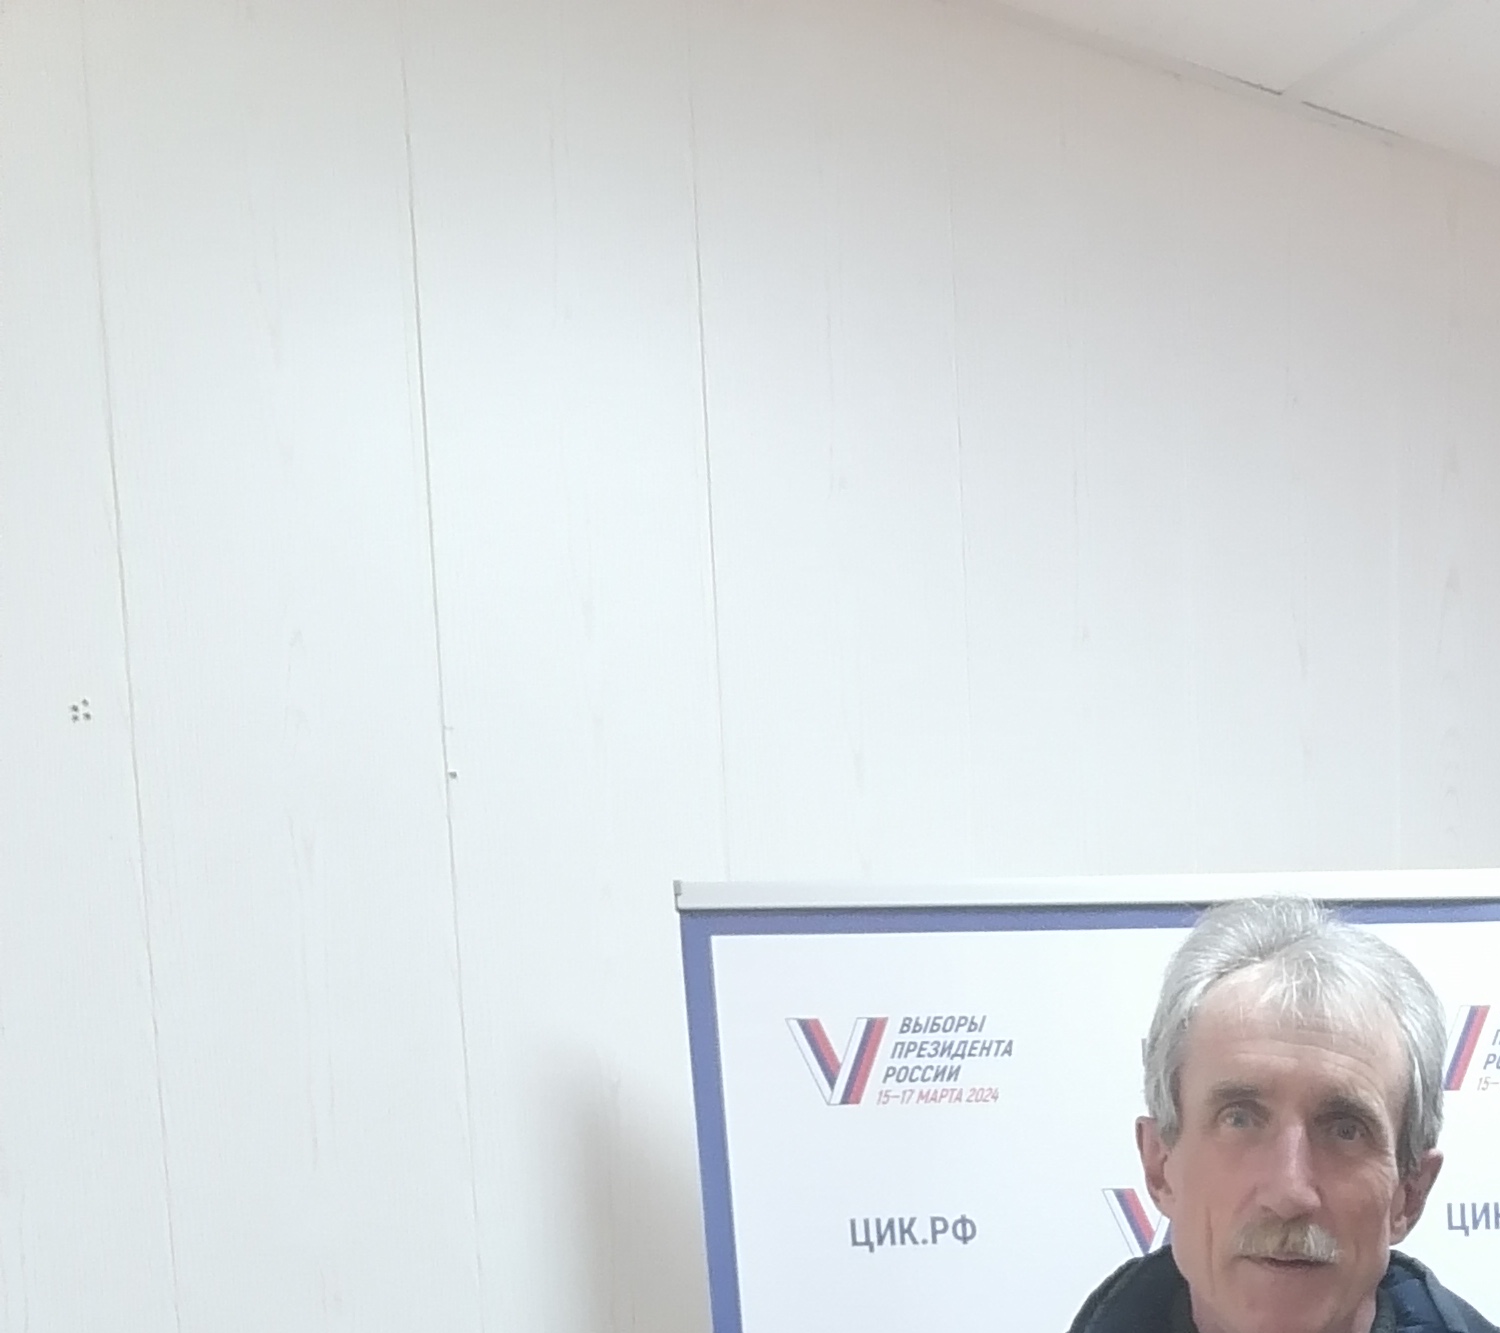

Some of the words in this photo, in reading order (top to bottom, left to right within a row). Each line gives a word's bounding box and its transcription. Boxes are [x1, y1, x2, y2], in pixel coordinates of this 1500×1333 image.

[898, 1015, 987, 1034] ВЫБОРЫ
[890, 1039, 1013, 1060] ПРЕЗИДЕНТА
[882, 1064, 961, 1084] РОССИИ
[916, 1088, 963, 1104] МАРТА
[965, 1087, 999, 1103] 2024
[849, 1214, 978, 1252] ЦИК.РФ
